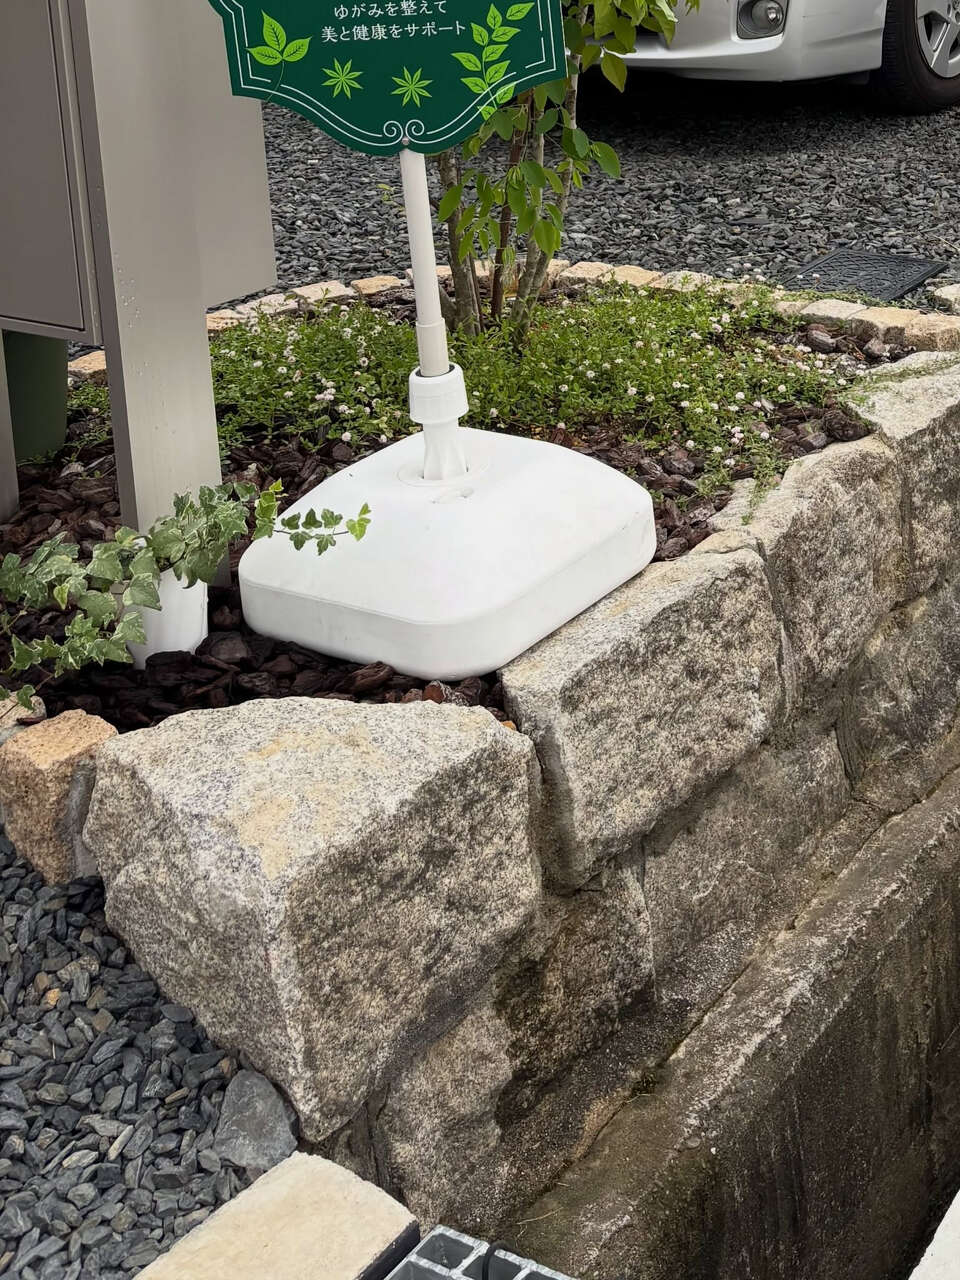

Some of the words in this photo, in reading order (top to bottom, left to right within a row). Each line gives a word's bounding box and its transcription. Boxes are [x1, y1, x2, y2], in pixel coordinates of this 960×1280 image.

[333, 0, 448, 19] ゆがみを整えて
[320, 20, 466, 43] 美と健康をサポート
